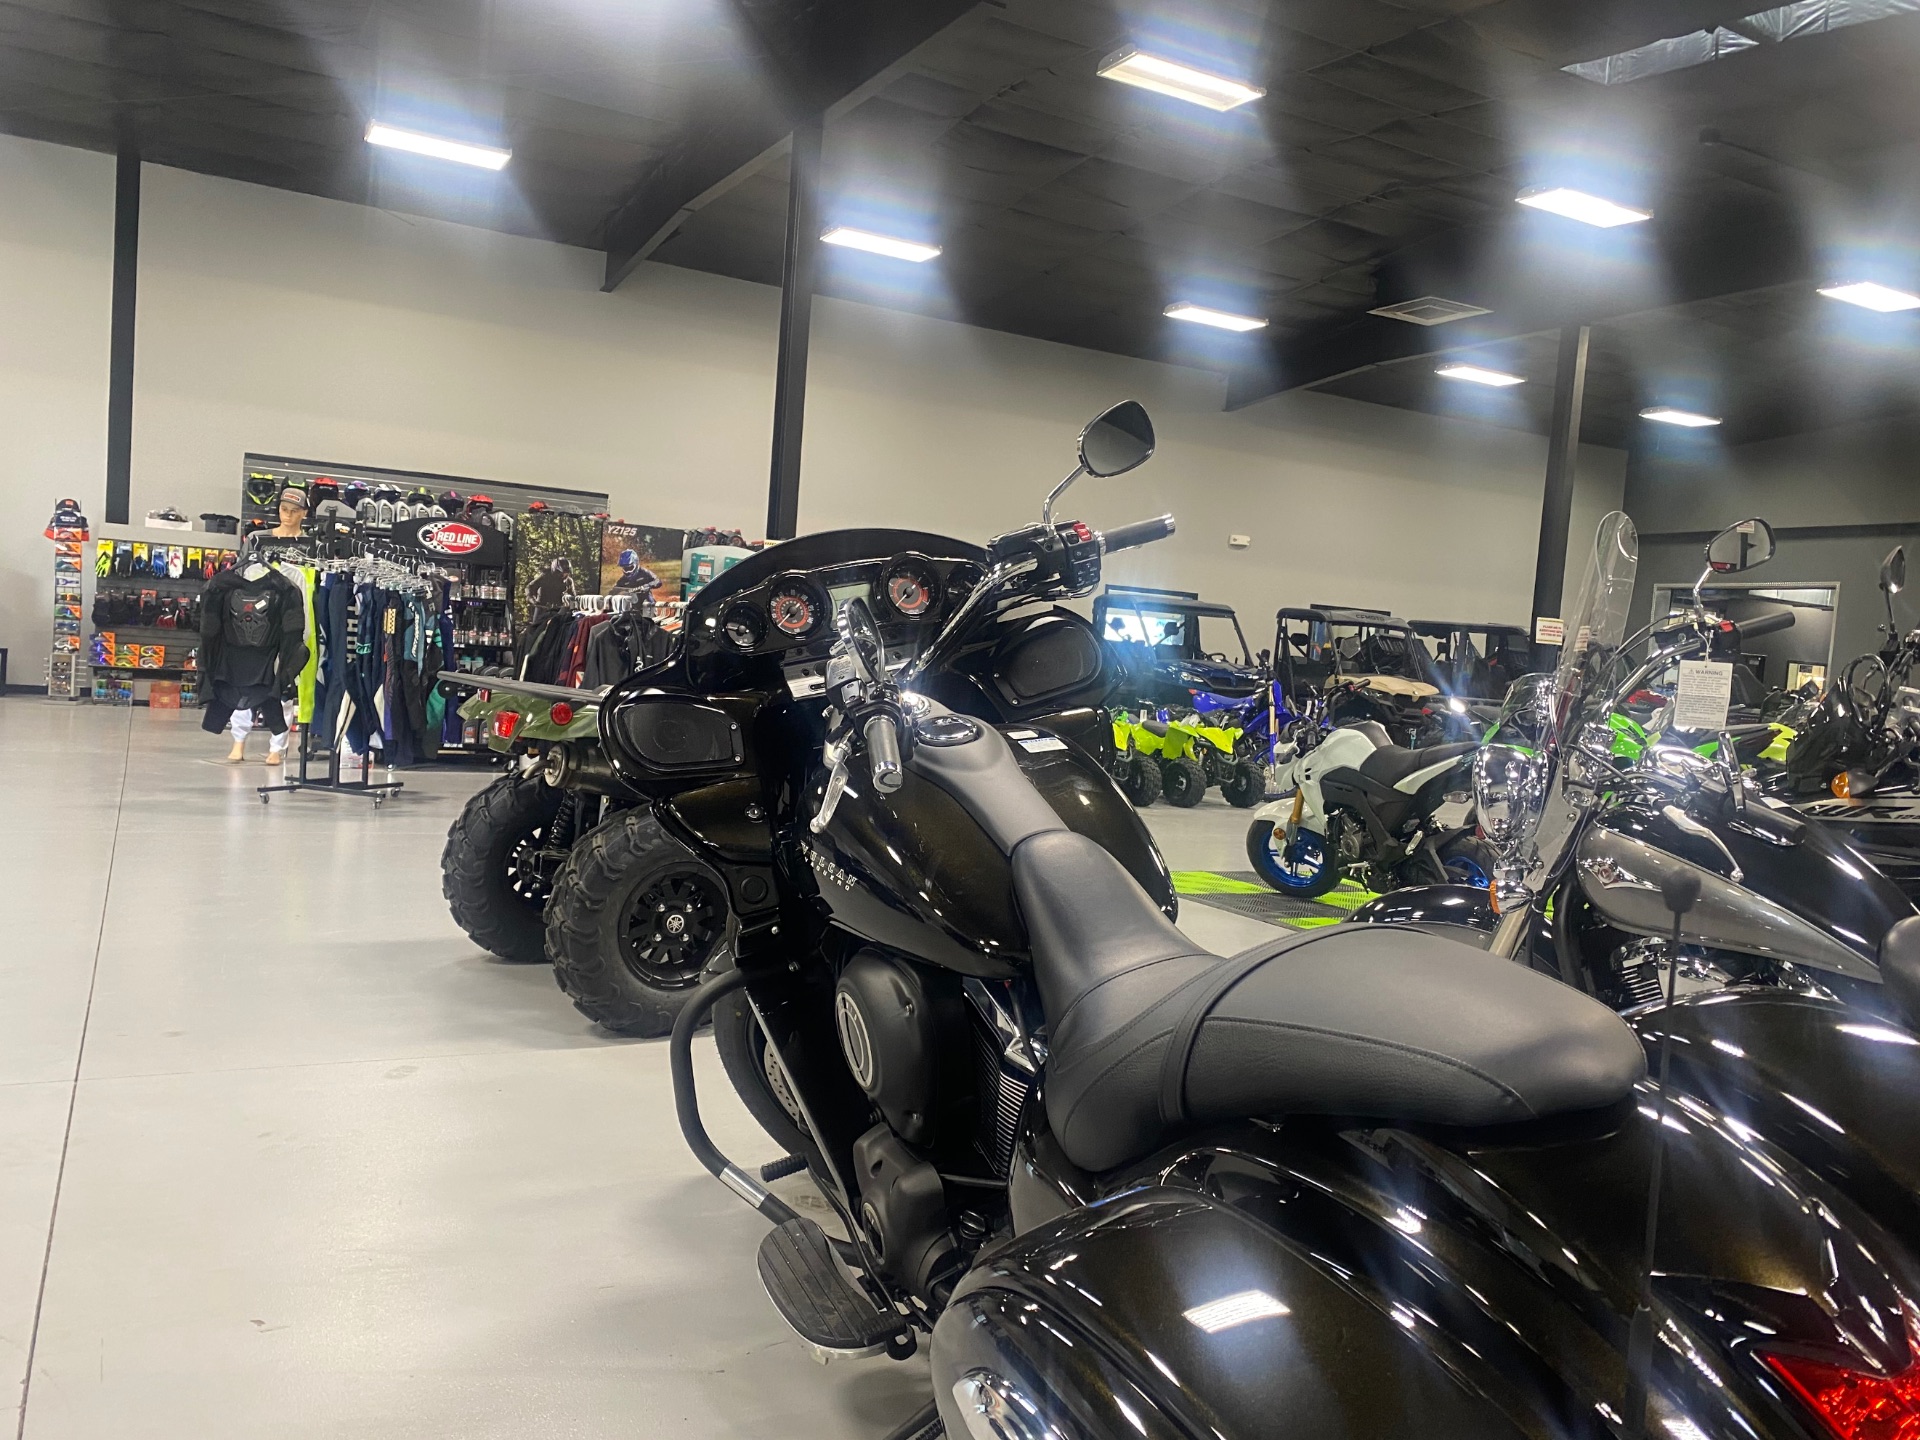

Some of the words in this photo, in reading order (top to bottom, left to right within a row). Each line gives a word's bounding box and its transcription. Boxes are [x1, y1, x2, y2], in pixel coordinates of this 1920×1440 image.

[436, 531, 455, 542] RED
[456, 532, 479, 545] LINE
[607, 525, 638, 537] YZ125
[800, 839, 858, 887] VULCAN
